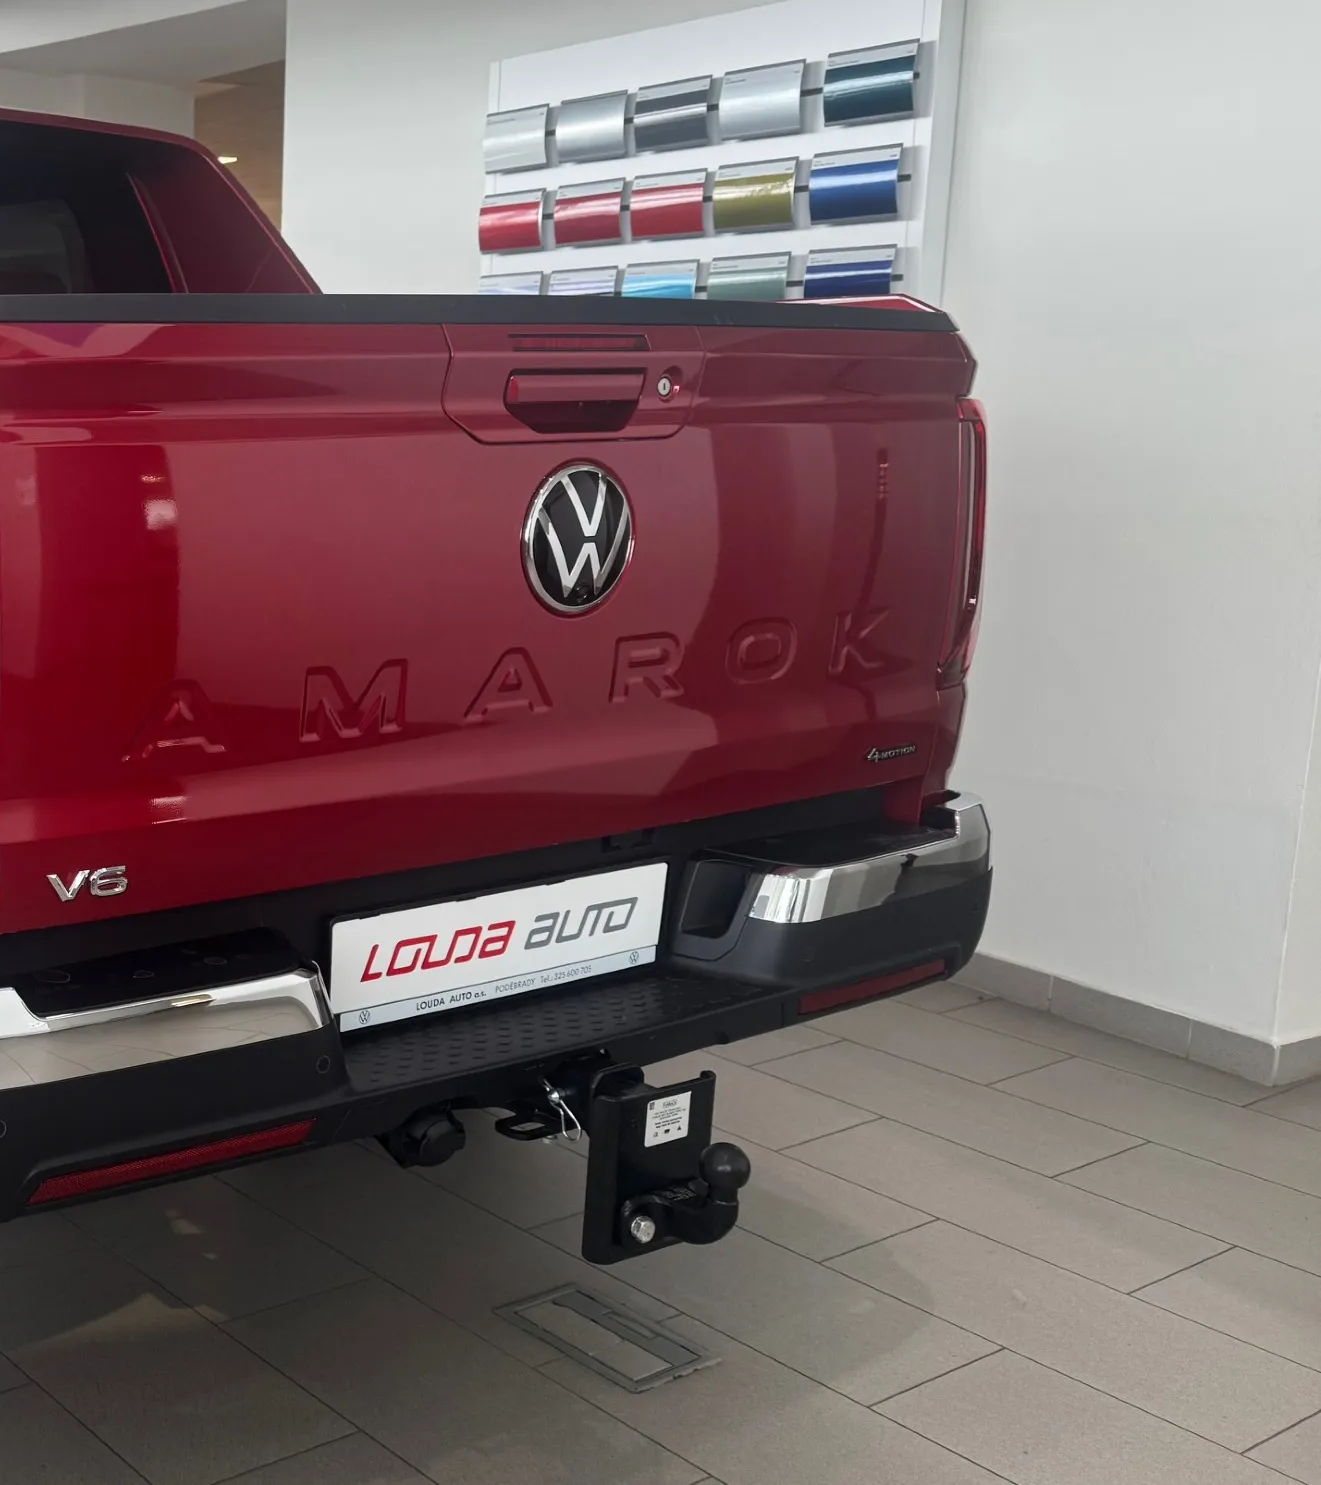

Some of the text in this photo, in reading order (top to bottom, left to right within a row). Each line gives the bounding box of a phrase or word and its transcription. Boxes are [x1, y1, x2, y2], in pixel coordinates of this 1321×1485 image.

[120, 608, 889, 763] AMAROK
[867, 745, 916, 762] 4MOTION
[46, 865, 128, 902] V6
[415, 997, 446, 1011] LOUDA
[449, 991, 473, 1004] AUTO
